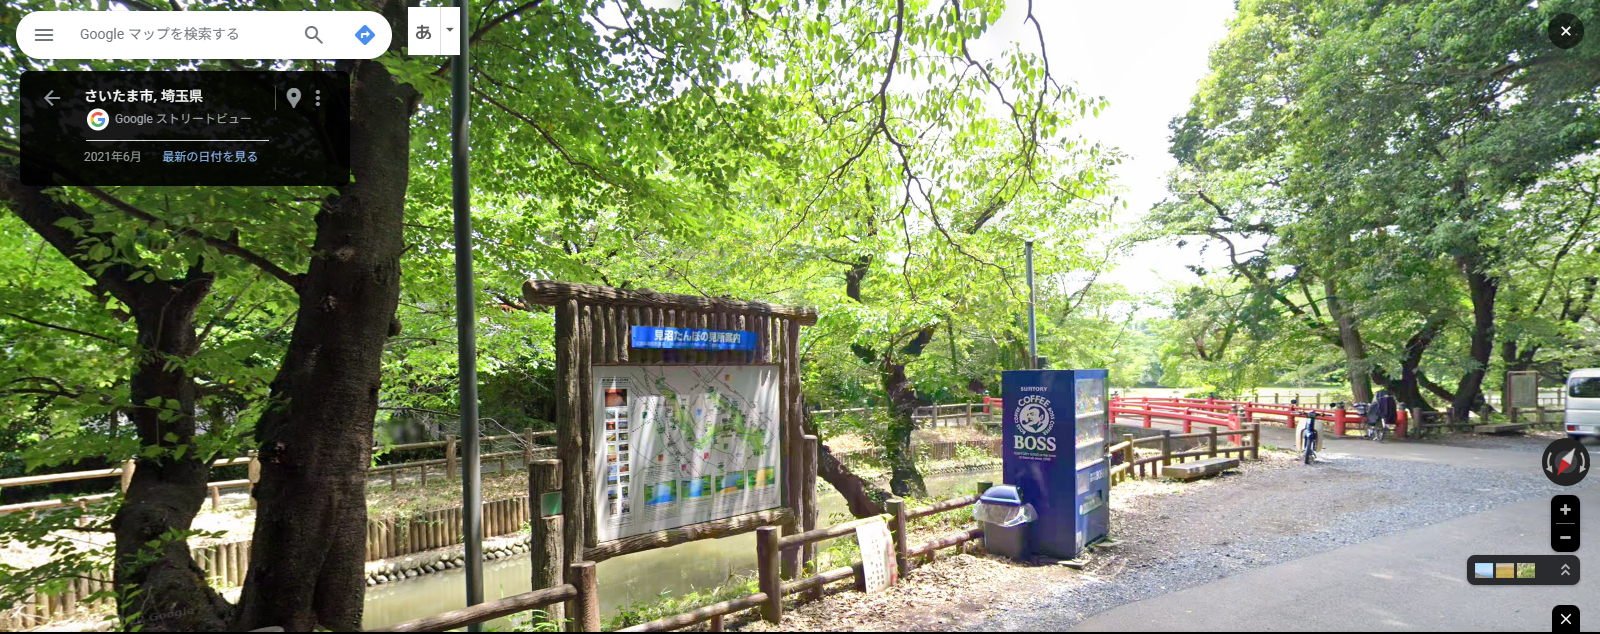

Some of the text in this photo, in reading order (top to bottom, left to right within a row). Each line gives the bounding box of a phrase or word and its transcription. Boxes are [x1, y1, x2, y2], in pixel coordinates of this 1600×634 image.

[654, 329, 741, 344] 見沼たんぼの見所案内
[1018, 394, 1051, 408] COFFEE
[1014, 435, 1056, 451] BOSS
